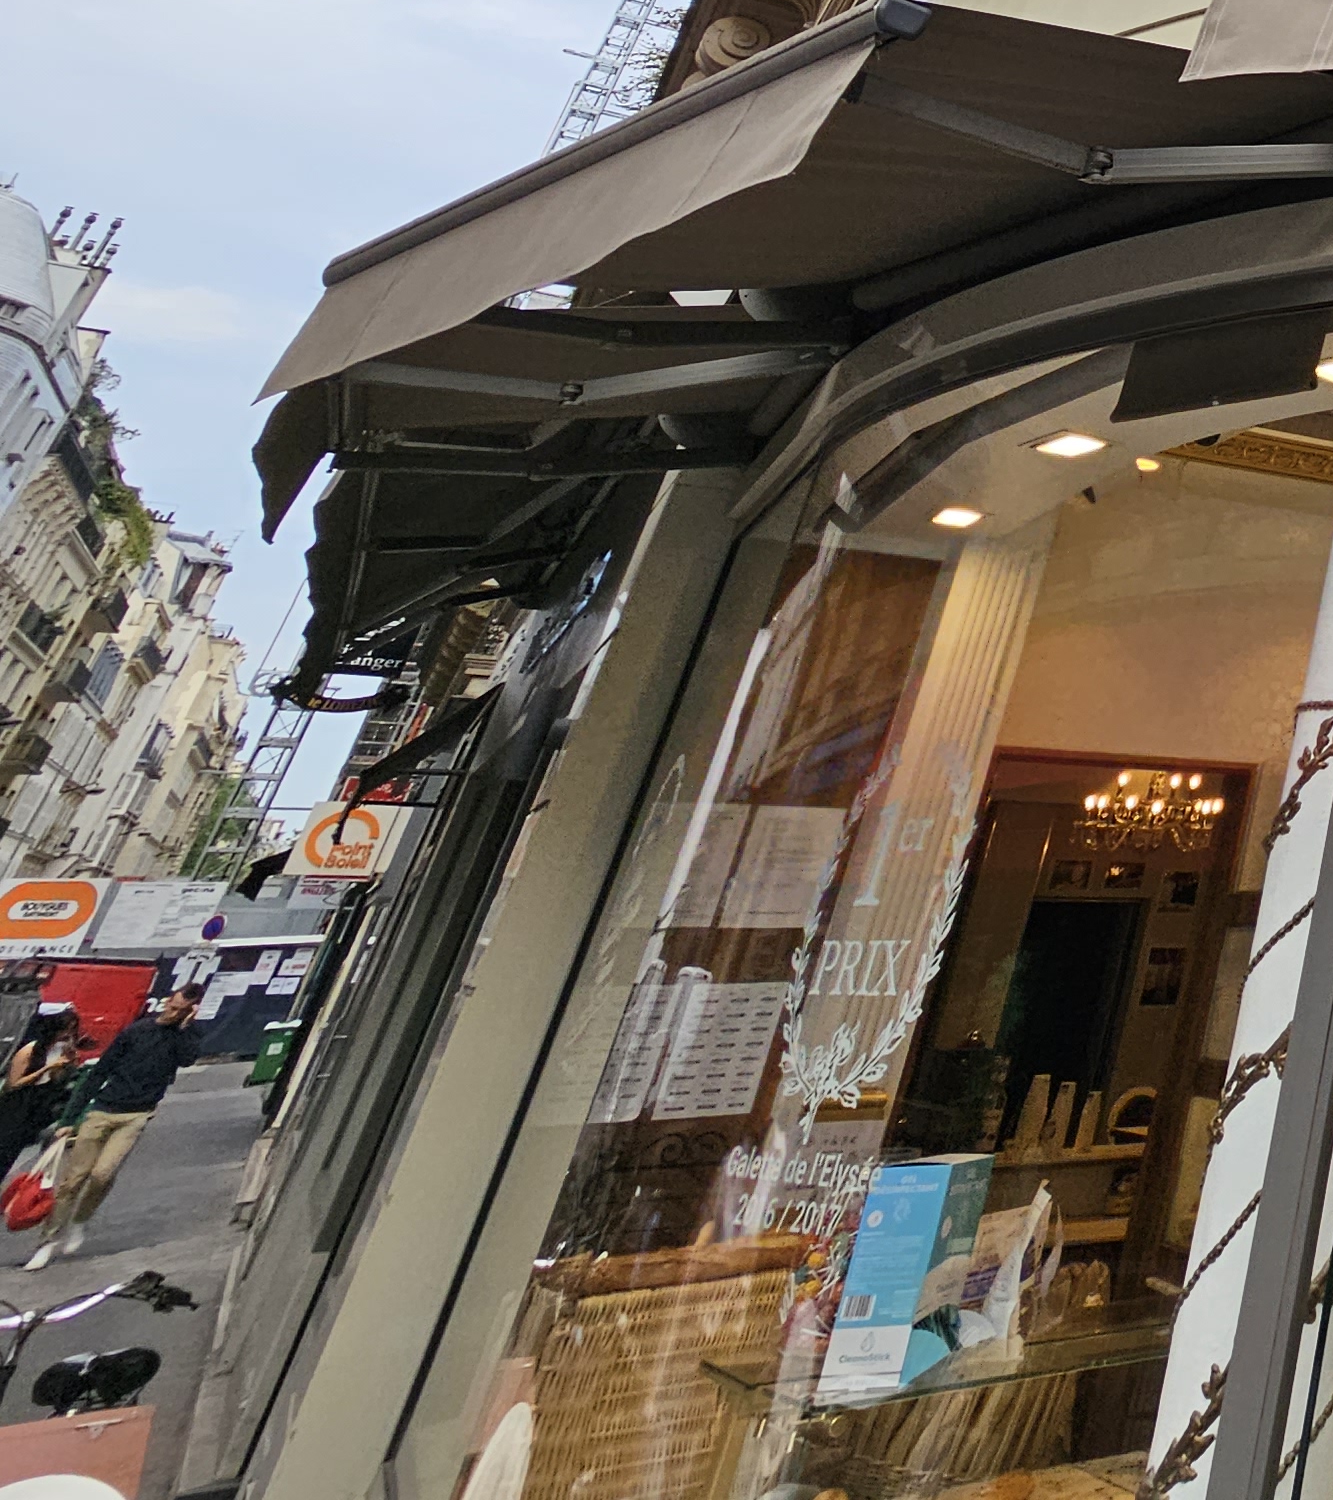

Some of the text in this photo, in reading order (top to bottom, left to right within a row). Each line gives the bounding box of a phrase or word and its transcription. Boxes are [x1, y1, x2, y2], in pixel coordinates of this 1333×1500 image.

[809, 939, 911, 997] PRIX
[784, 1152, 807, 1185] de
[732, 1193, 777, 1230] 206
